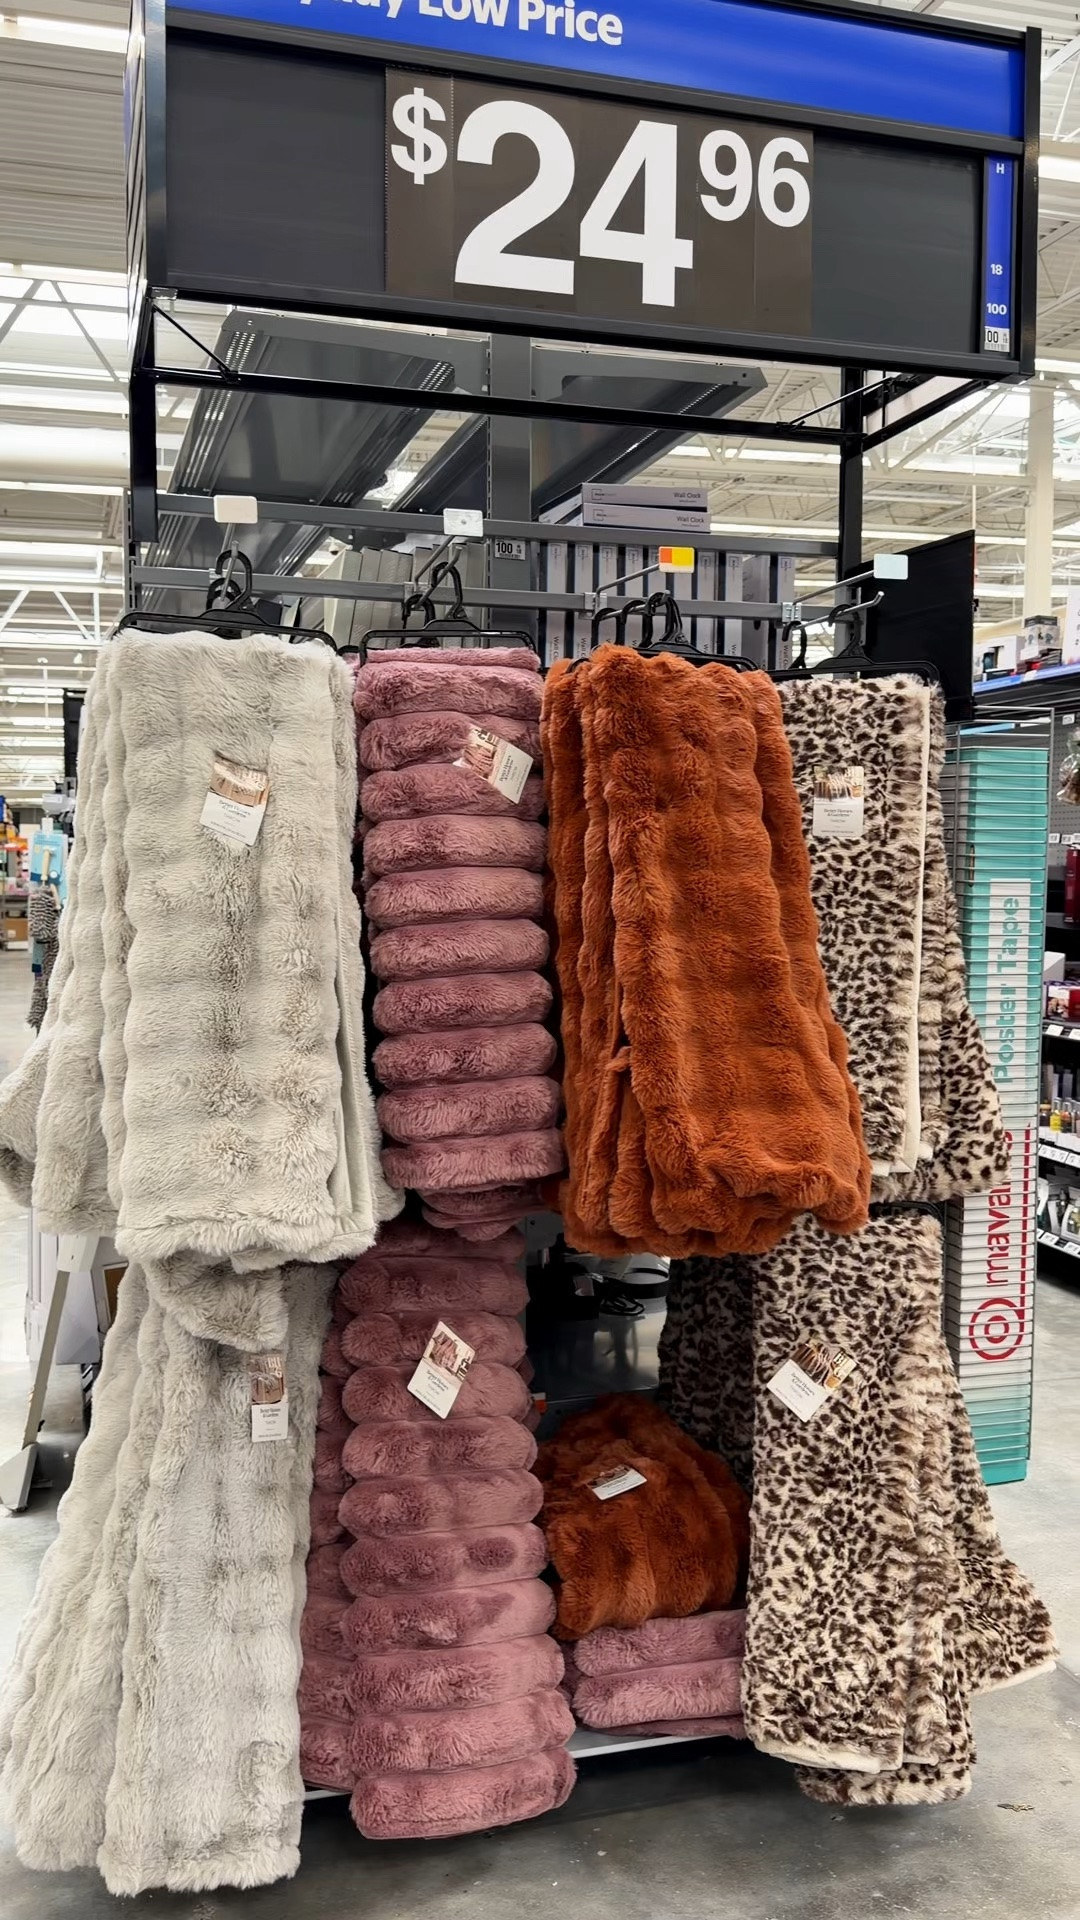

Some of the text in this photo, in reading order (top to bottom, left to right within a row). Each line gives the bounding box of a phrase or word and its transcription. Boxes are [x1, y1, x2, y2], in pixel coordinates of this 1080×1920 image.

[528, 0, 623, 46] Price
[996, 163, 1005, 174] H
[990, 264, 1003, 275] 18
[986, 303, 1007, 316] 100
[676, 515, 690, 523] Wall
[496, 542, 513, 554] 100
[993, 897, 1022, 1084] Poster Tape
